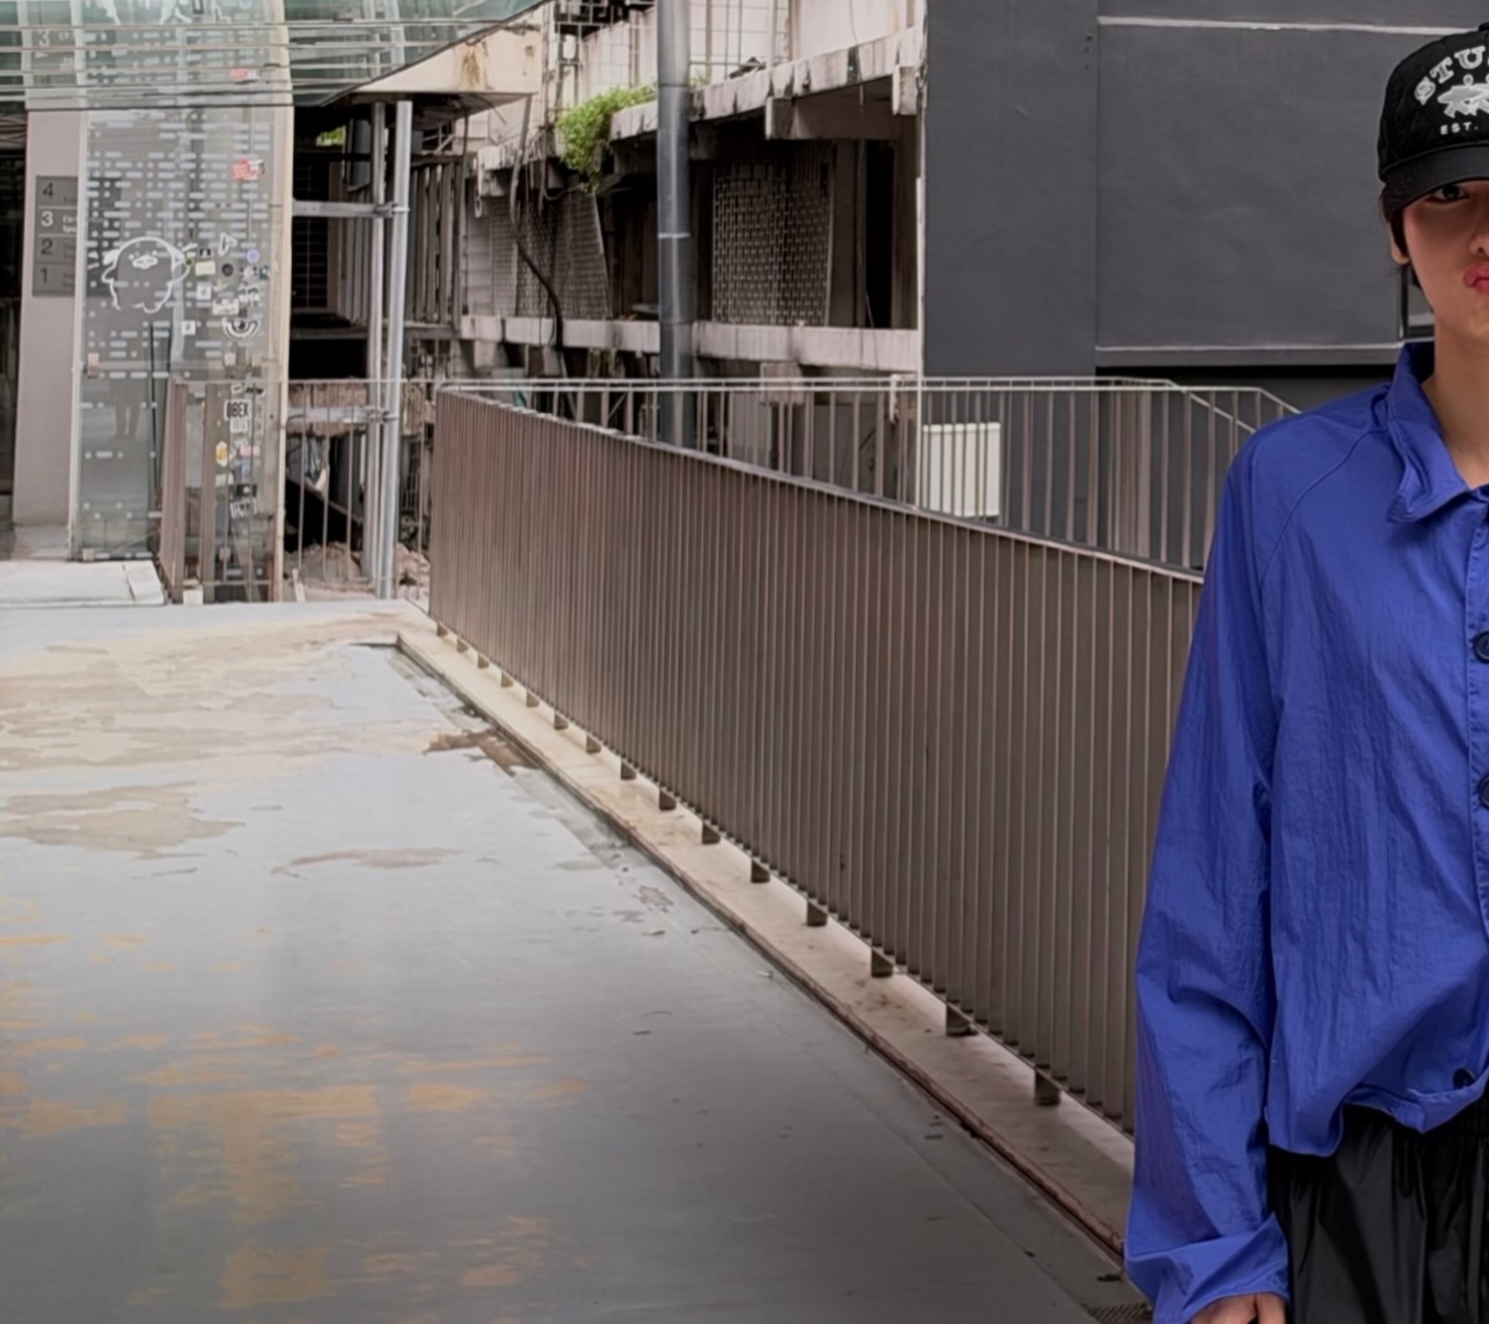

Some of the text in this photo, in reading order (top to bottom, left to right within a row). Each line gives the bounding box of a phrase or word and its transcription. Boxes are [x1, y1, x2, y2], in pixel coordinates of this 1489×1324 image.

[1440, 121, 1479, 135] EST.
[41, 181, 55, 200] 4
[40, 210, 55, 227] 3
[40, 238, 54, 256] 2
[39, 266, 49, 284] 1
